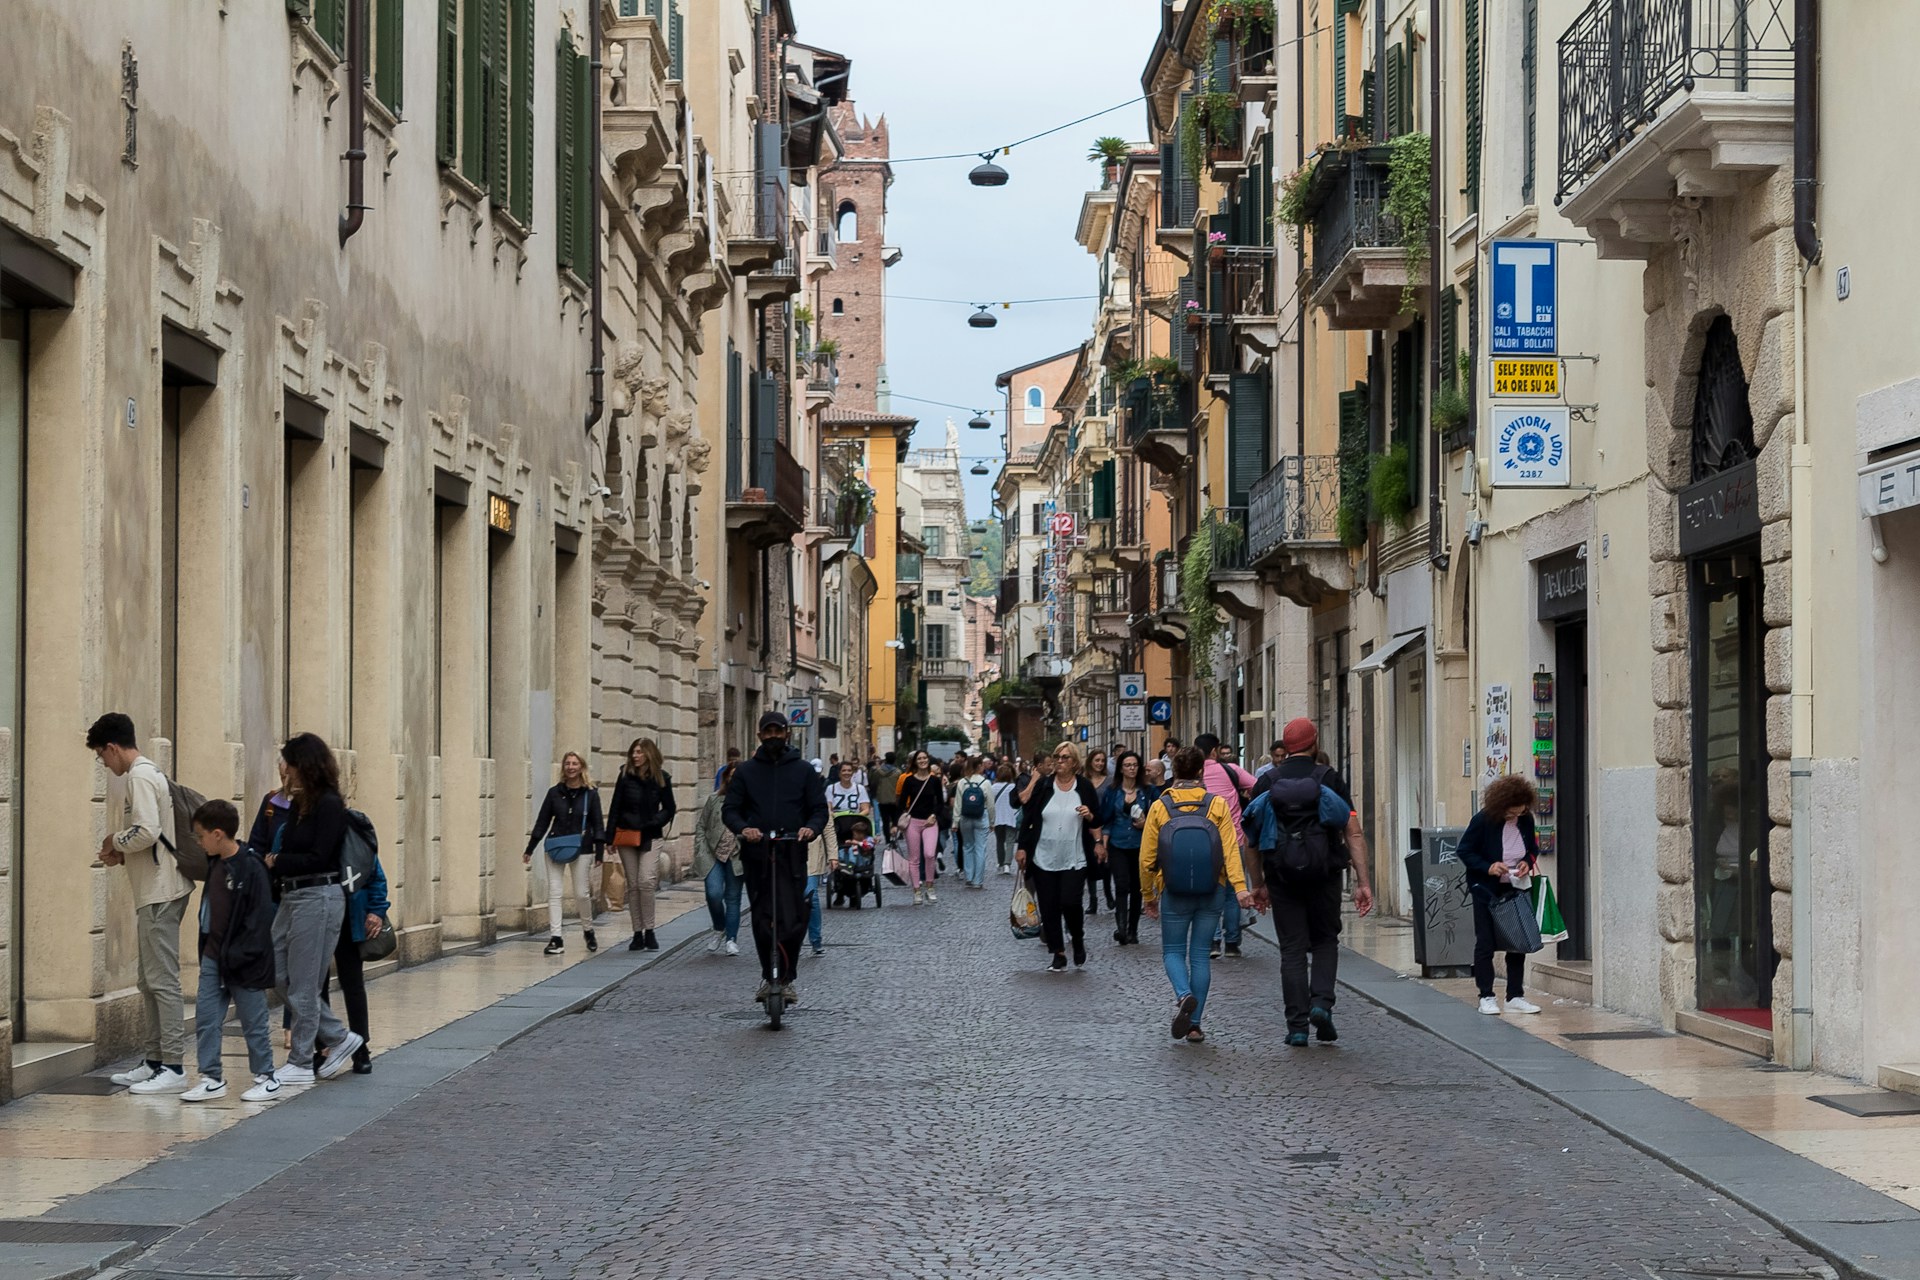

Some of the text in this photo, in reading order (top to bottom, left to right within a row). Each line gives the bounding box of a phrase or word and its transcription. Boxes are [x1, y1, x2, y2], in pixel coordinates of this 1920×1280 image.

[1498, 247, 1550, 323] T
[1536, 305, 1552, 313] RIV.
[1494, 326, 1553, 337] SALI TABACCHI
[1494, 338, 1553, 348] VALORI BOLLATI
[1498, 364, 1554, 376] SELF SERVICE
[1497, 380, 1555, 392] 24 ORE SU 24
[1499, 415, 1563, 467] RICEVITORIA LOTTO
[1520, 470, 1543, 479] 2387
[1053, 516, 1072, 531] 12
[1043, 500, 1057, 656] MELEGATTI
[833, 793, 858, 810] 78
